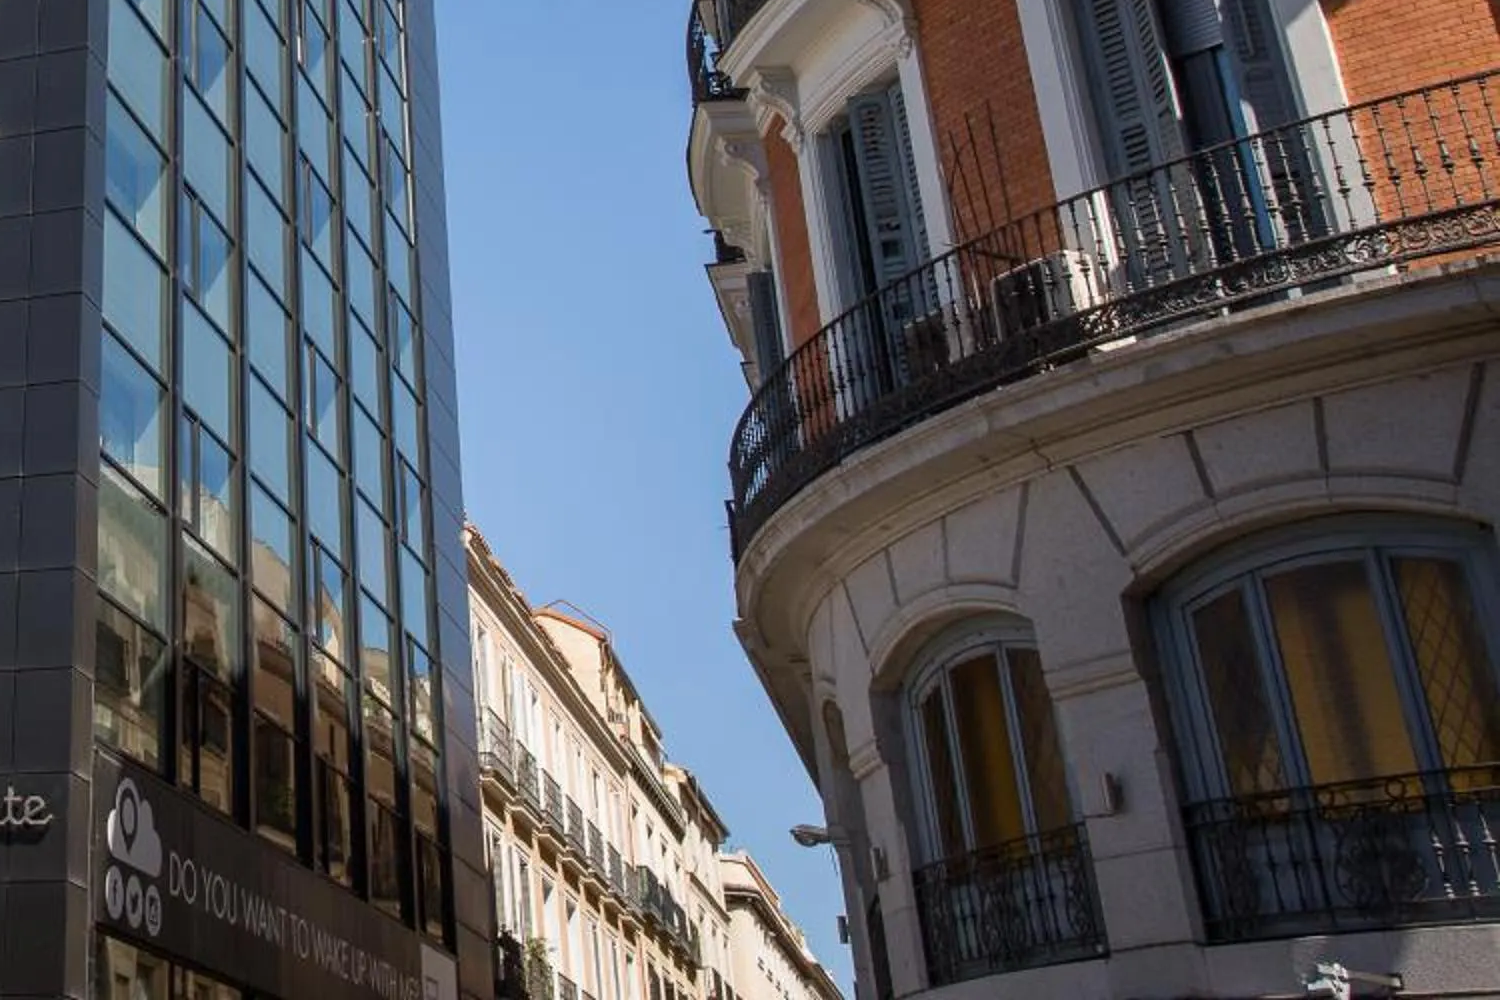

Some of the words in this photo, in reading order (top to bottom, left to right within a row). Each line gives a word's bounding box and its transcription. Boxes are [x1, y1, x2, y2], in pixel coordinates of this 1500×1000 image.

[169, 851, 197, 905] DO
[201, 865, 237, 925] YOU
[241, 887, 287, 947] WANT
[290, 913, 309, 959] TO
[311, 922, 349, 980] WAKE
[350, 945, 367, 985] UP
